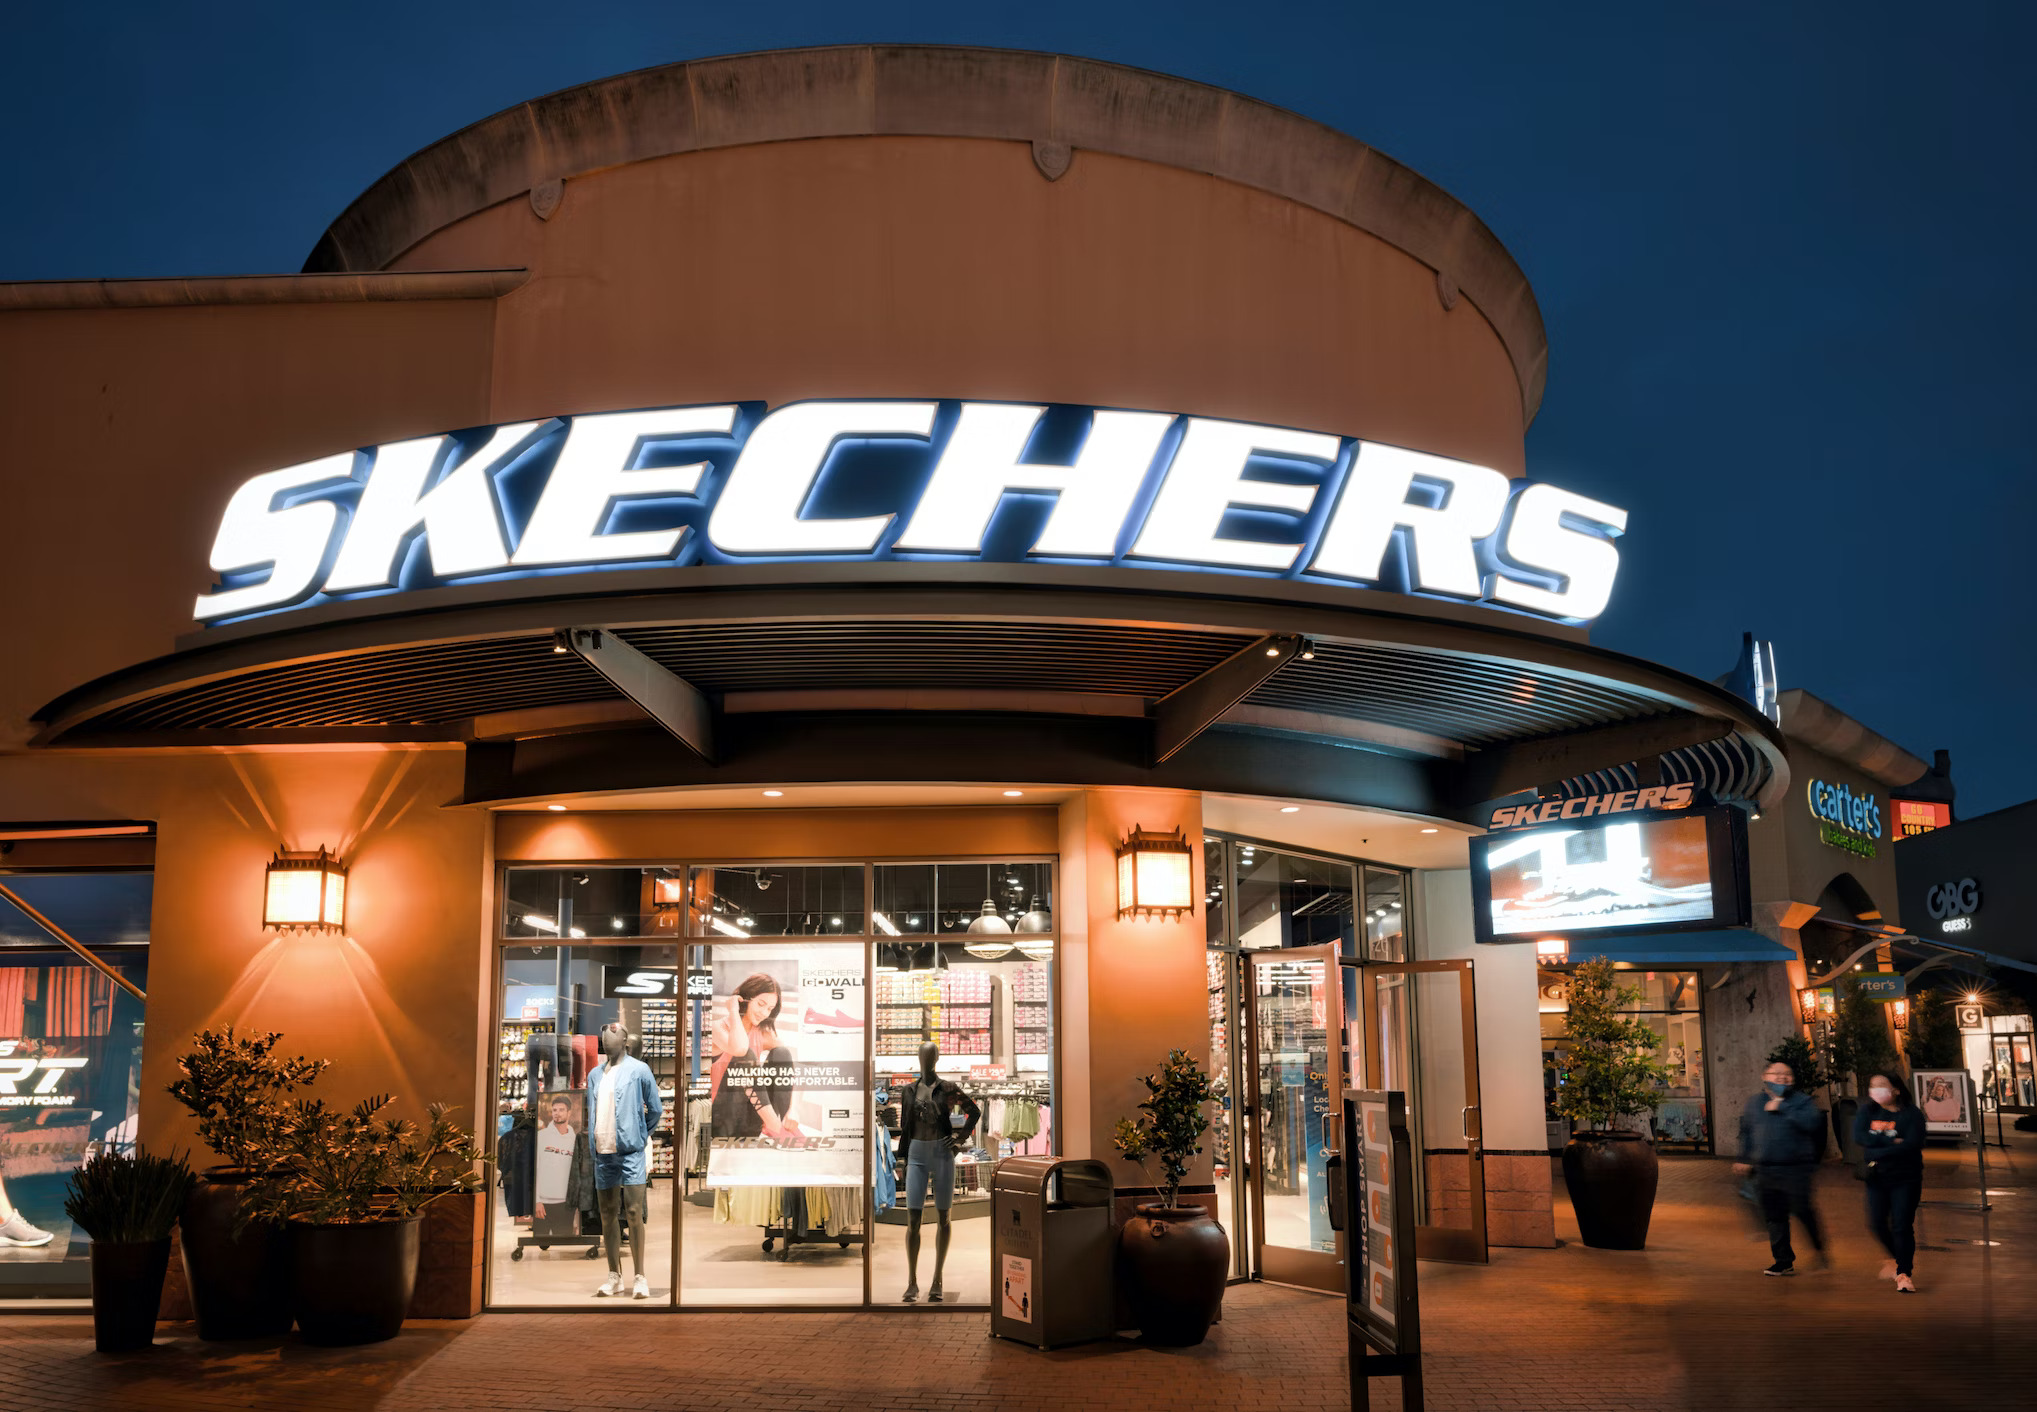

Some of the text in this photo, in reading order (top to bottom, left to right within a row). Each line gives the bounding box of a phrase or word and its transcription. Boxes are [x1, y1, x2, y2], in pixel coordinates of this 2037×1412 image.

[193, 400, 1628, 622] SKECHERS
[1489, 782, 1694, 829] SKECHERS
[1812, 780, 1882, 838] carter's
[832, 989, 844, 1000] 5
[1962, 1008, 1978, 1024] G
[727, 1067, 840, 1077] WALKING HAS NEVER
[727, 1077, 858, 1086] BEEN SO COMFORTABLE.
[711, 1136, 836, 1149] SKECHERS
[1355, 1109, 1369, 1266] SHOP SMART
